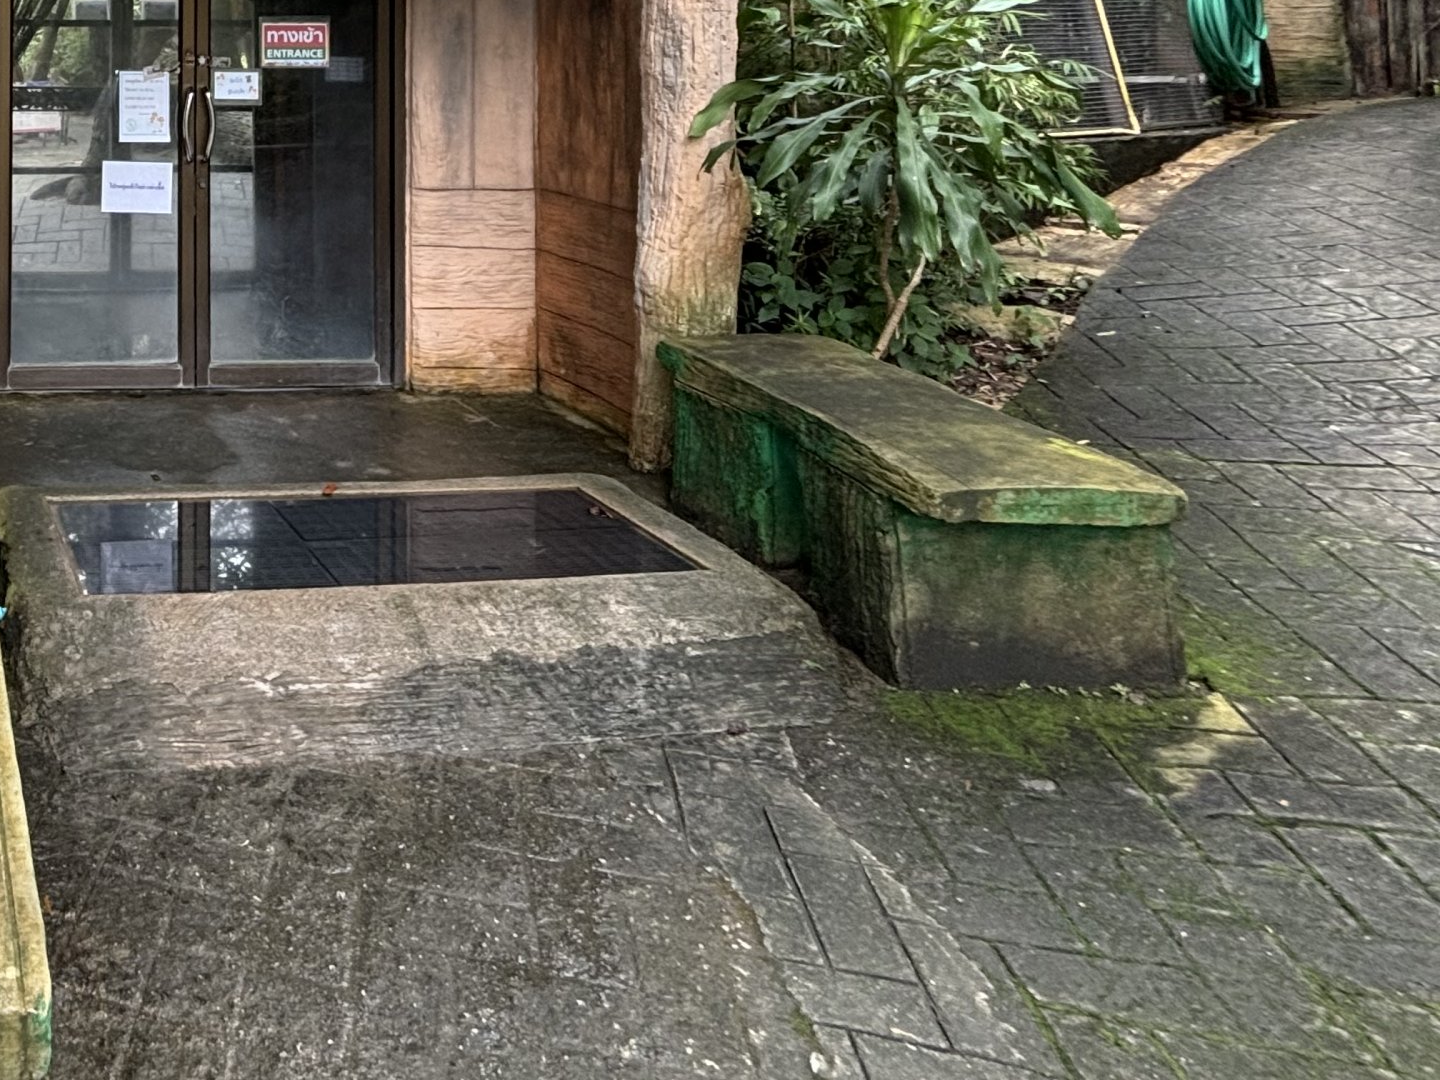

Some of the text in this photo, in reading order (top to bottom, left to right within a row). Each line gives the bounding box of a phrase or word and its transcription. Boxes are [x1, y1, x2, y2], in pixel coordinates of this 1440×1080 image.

[267, 27, 323, 43] ทางเข้า
[267, 49, 323, 58] ENTRANCE
